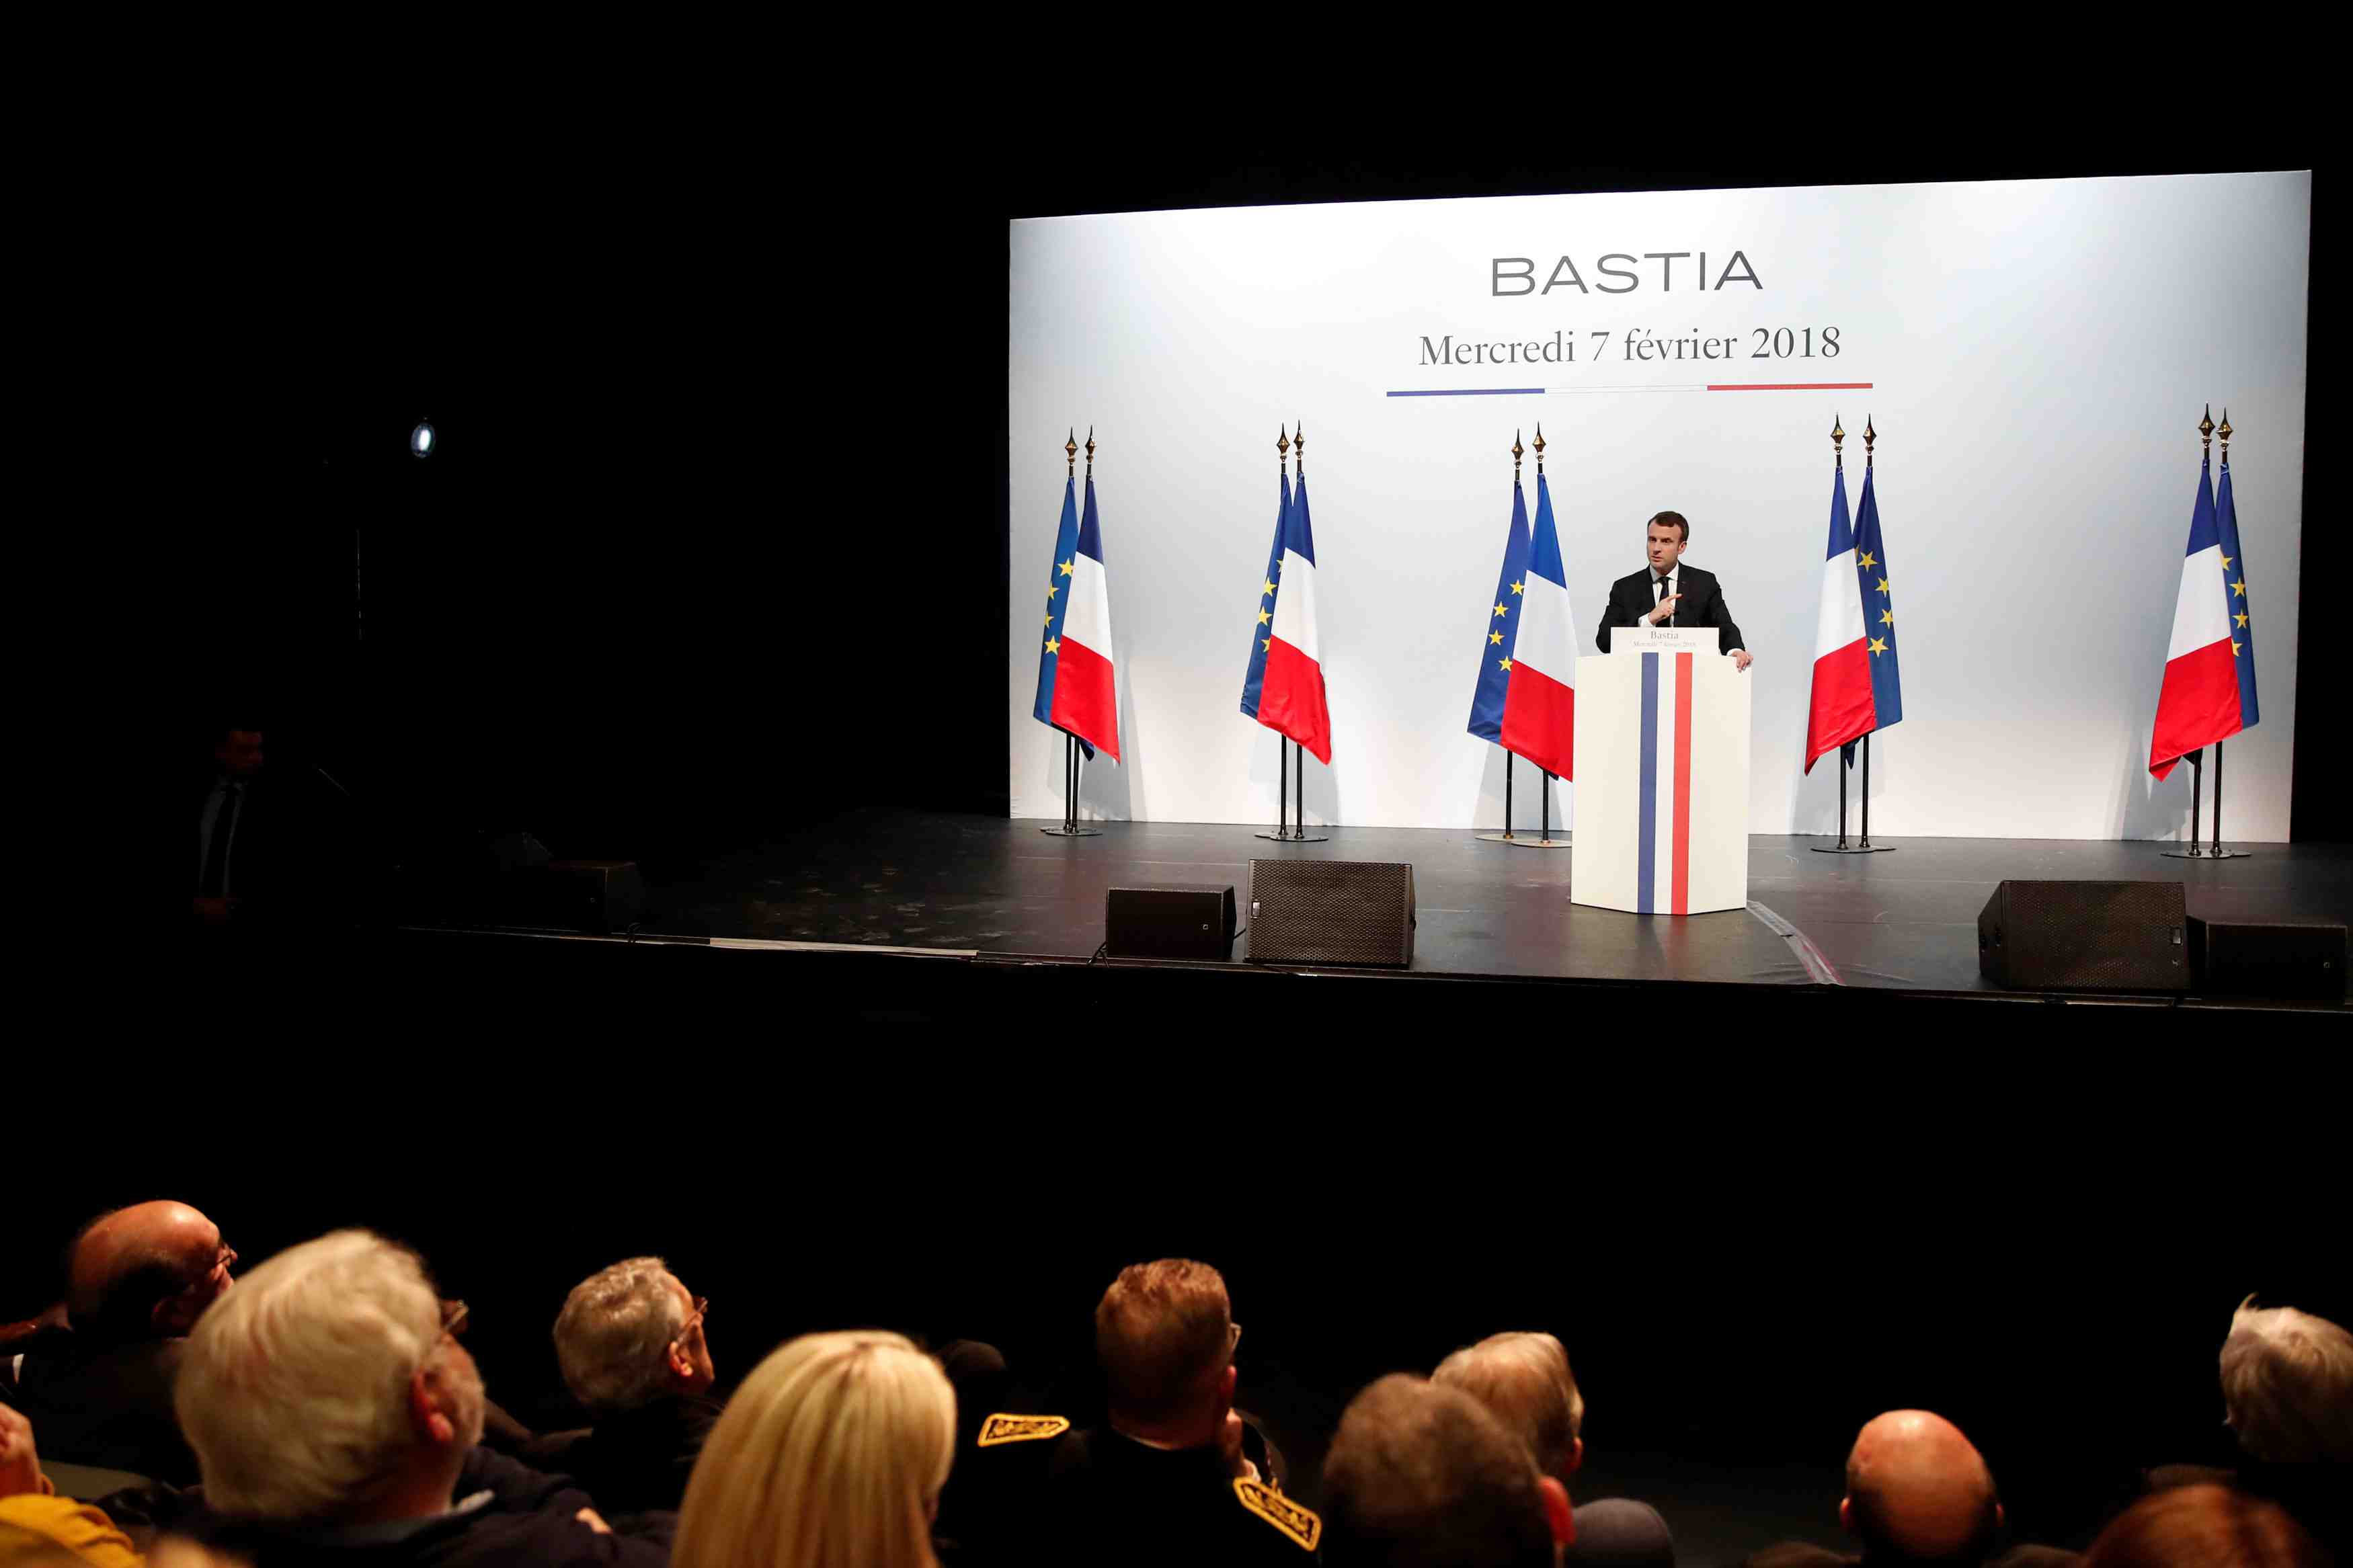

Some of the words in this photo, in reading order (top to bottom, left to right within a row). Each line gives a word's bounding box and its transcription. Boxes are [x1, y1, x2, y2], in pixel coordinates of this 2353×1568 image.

[1492, 250, 1763, 296] BASTIA
[1419, 330, 1575, 365] Mercredi
[1591, 331, 1610, 361] 7
[1624, 327, 1738, 361] février
[1751, 327, 1840, 358] 2018
[1650, 630, 1679, 639] Bastia
